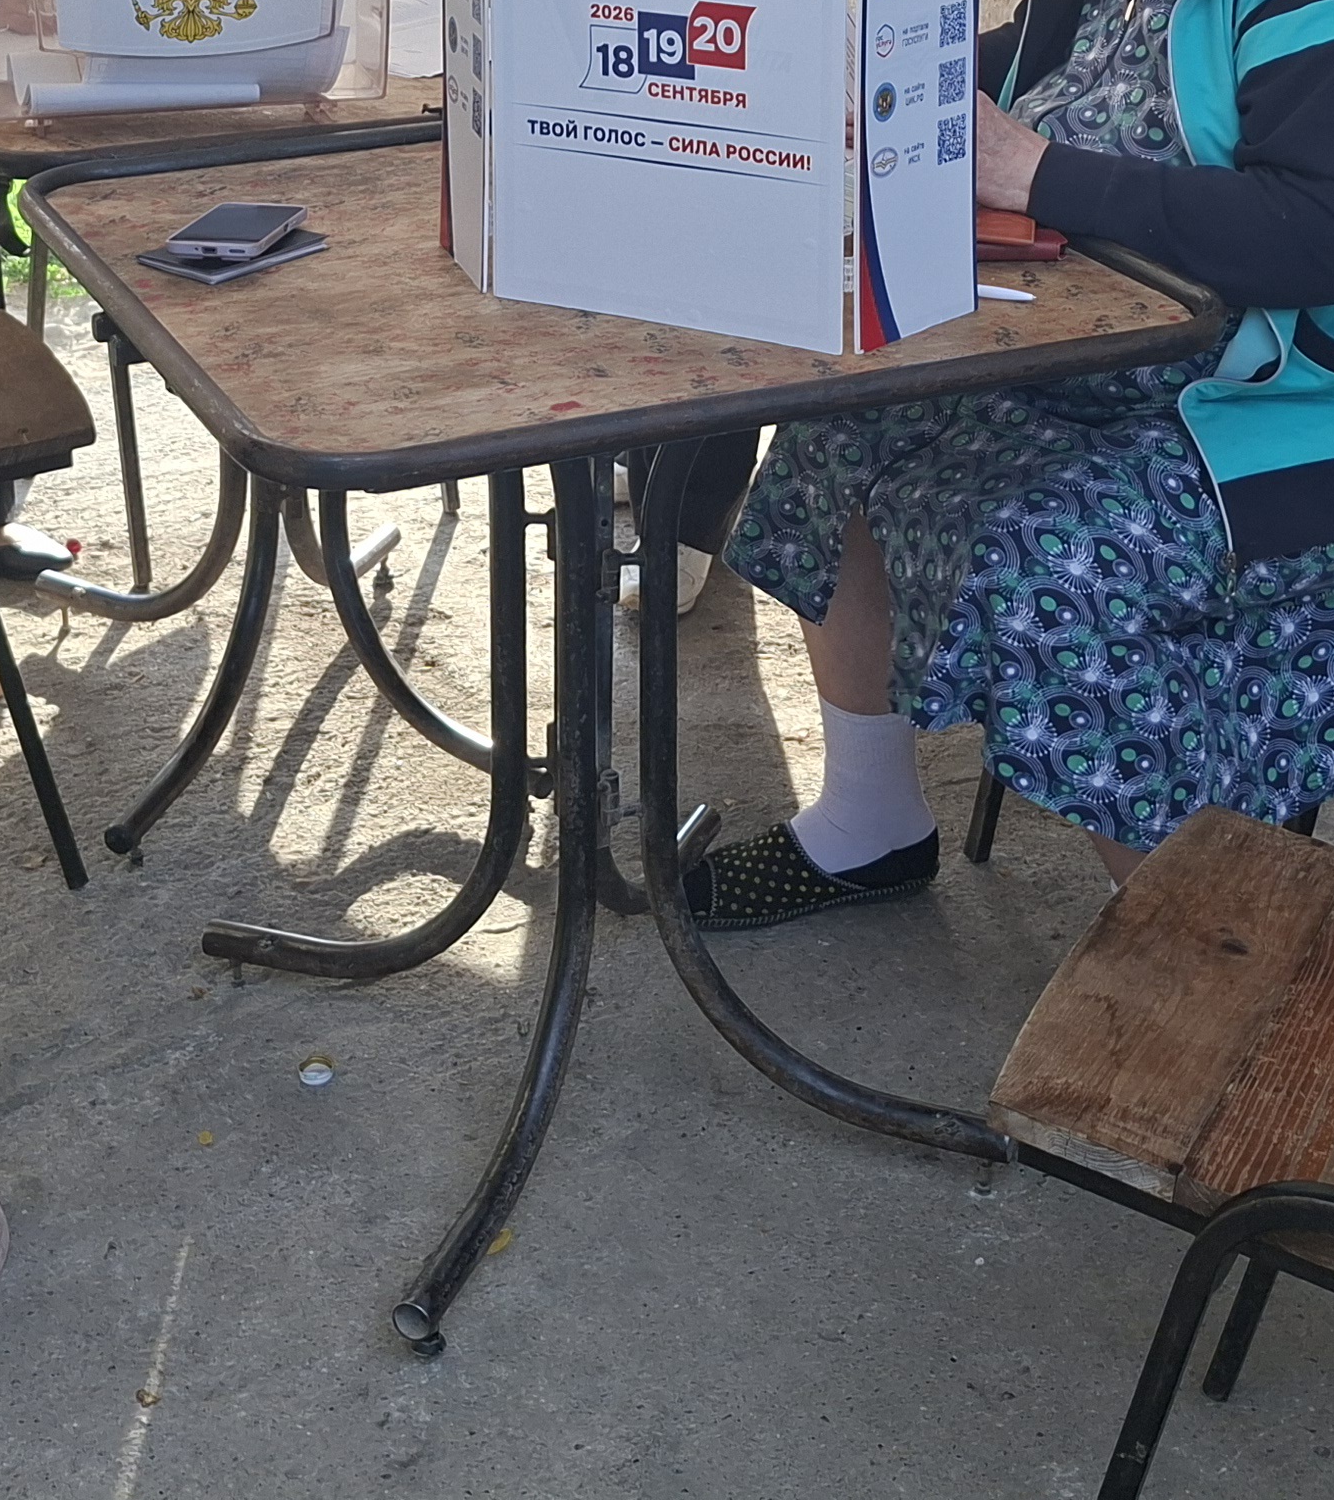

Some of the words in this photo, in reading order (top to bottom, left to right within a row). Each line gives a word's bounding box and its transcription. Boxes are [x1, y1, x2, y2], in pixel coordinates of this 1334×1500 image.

[590, 3, 635, 23] 2026
[596, 43, 635, 80] 18
[644, 28, 684, 66] 19
[692, 16, 743, 54] 20
[647, 81, 747, 109] СЕНТЯБРЯ
[527, 117, 579, 140] ТВОЙ
[582, 125, 647, 148] ГОЛОС
[668, 136, 721, 157] СИЛА
[725, 142, 813, 172] РОССИИ!
